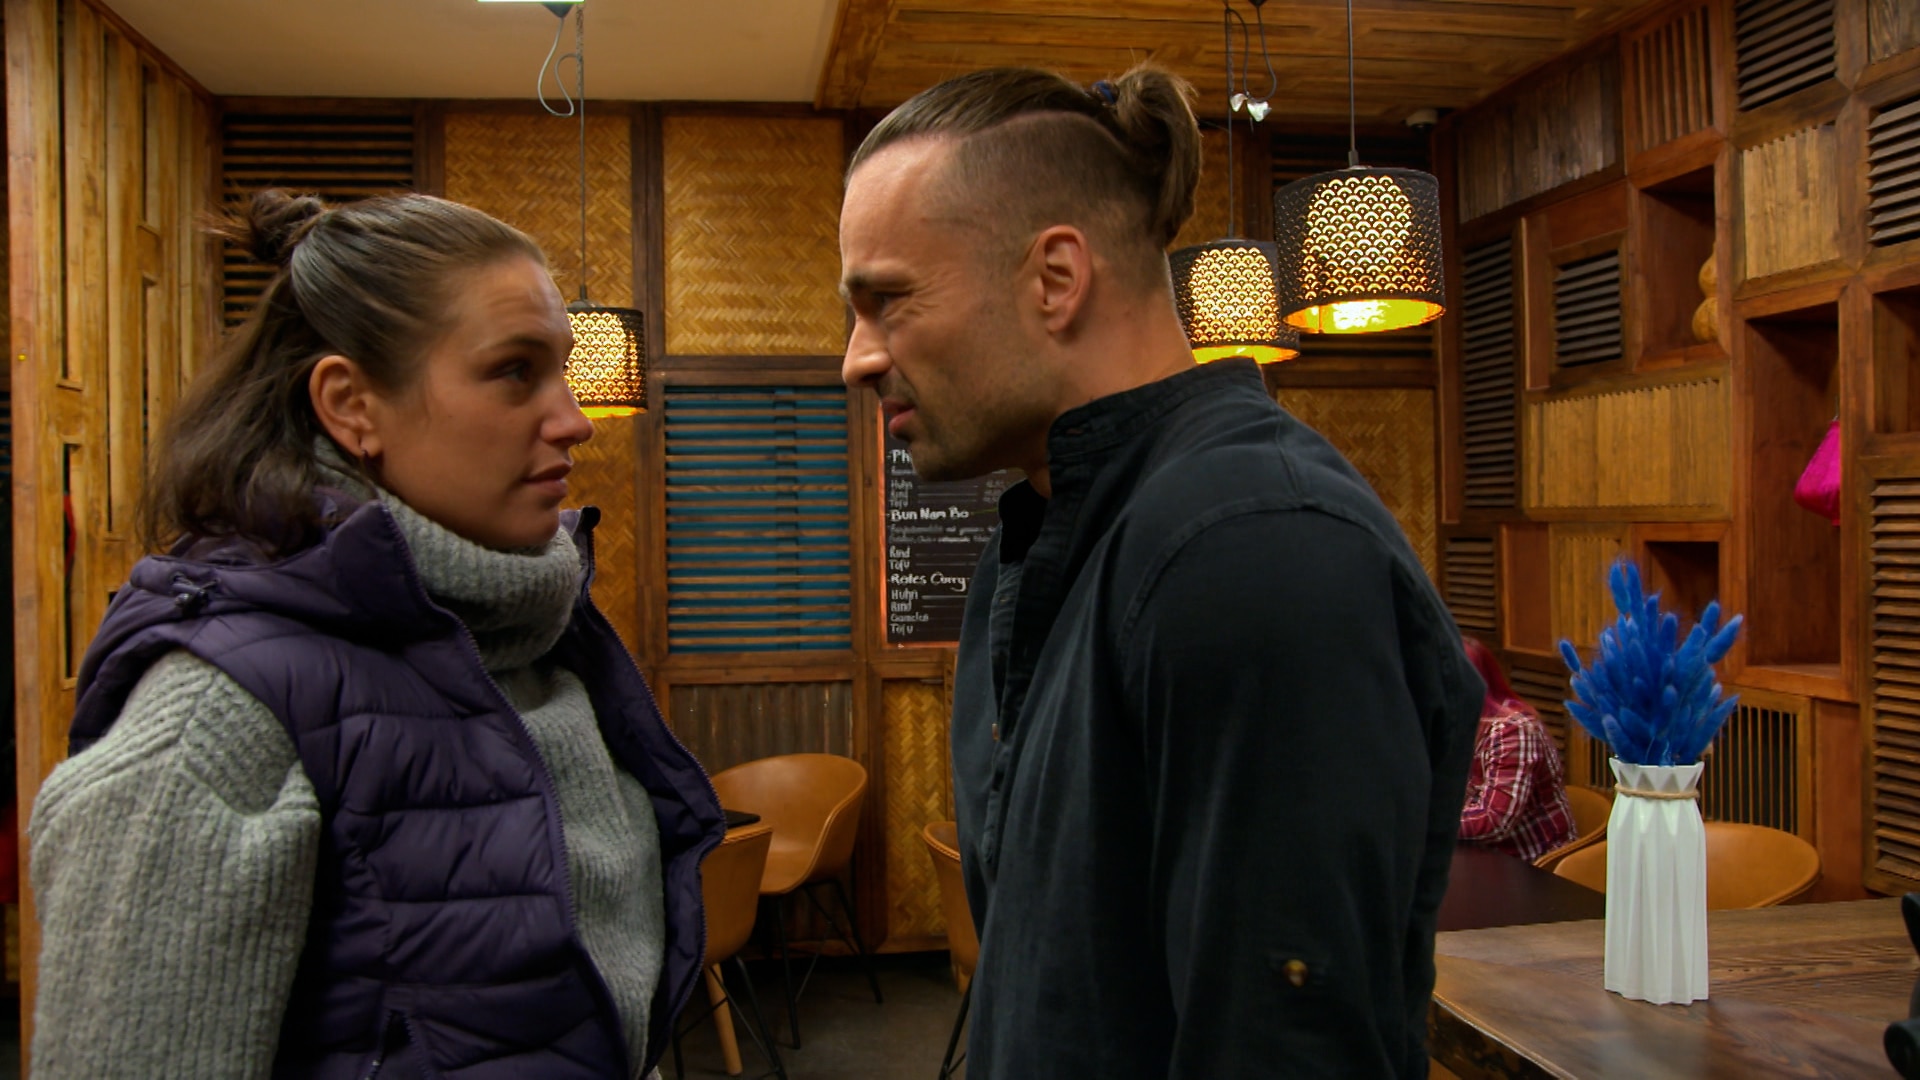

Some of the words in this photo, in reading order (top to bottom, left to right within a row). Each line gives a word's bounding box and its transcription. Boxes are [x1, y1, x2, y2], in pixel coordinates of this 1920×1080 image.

[890, 509, 918, 521] Bun
[889, 545, 911, 558] Rind
[889, 560, 910, 572] Tofu
[891, 588, 919, 601] Huhn
[890, 600, 912, 612] Rind
[889, 623, 914, 636] Tofu
